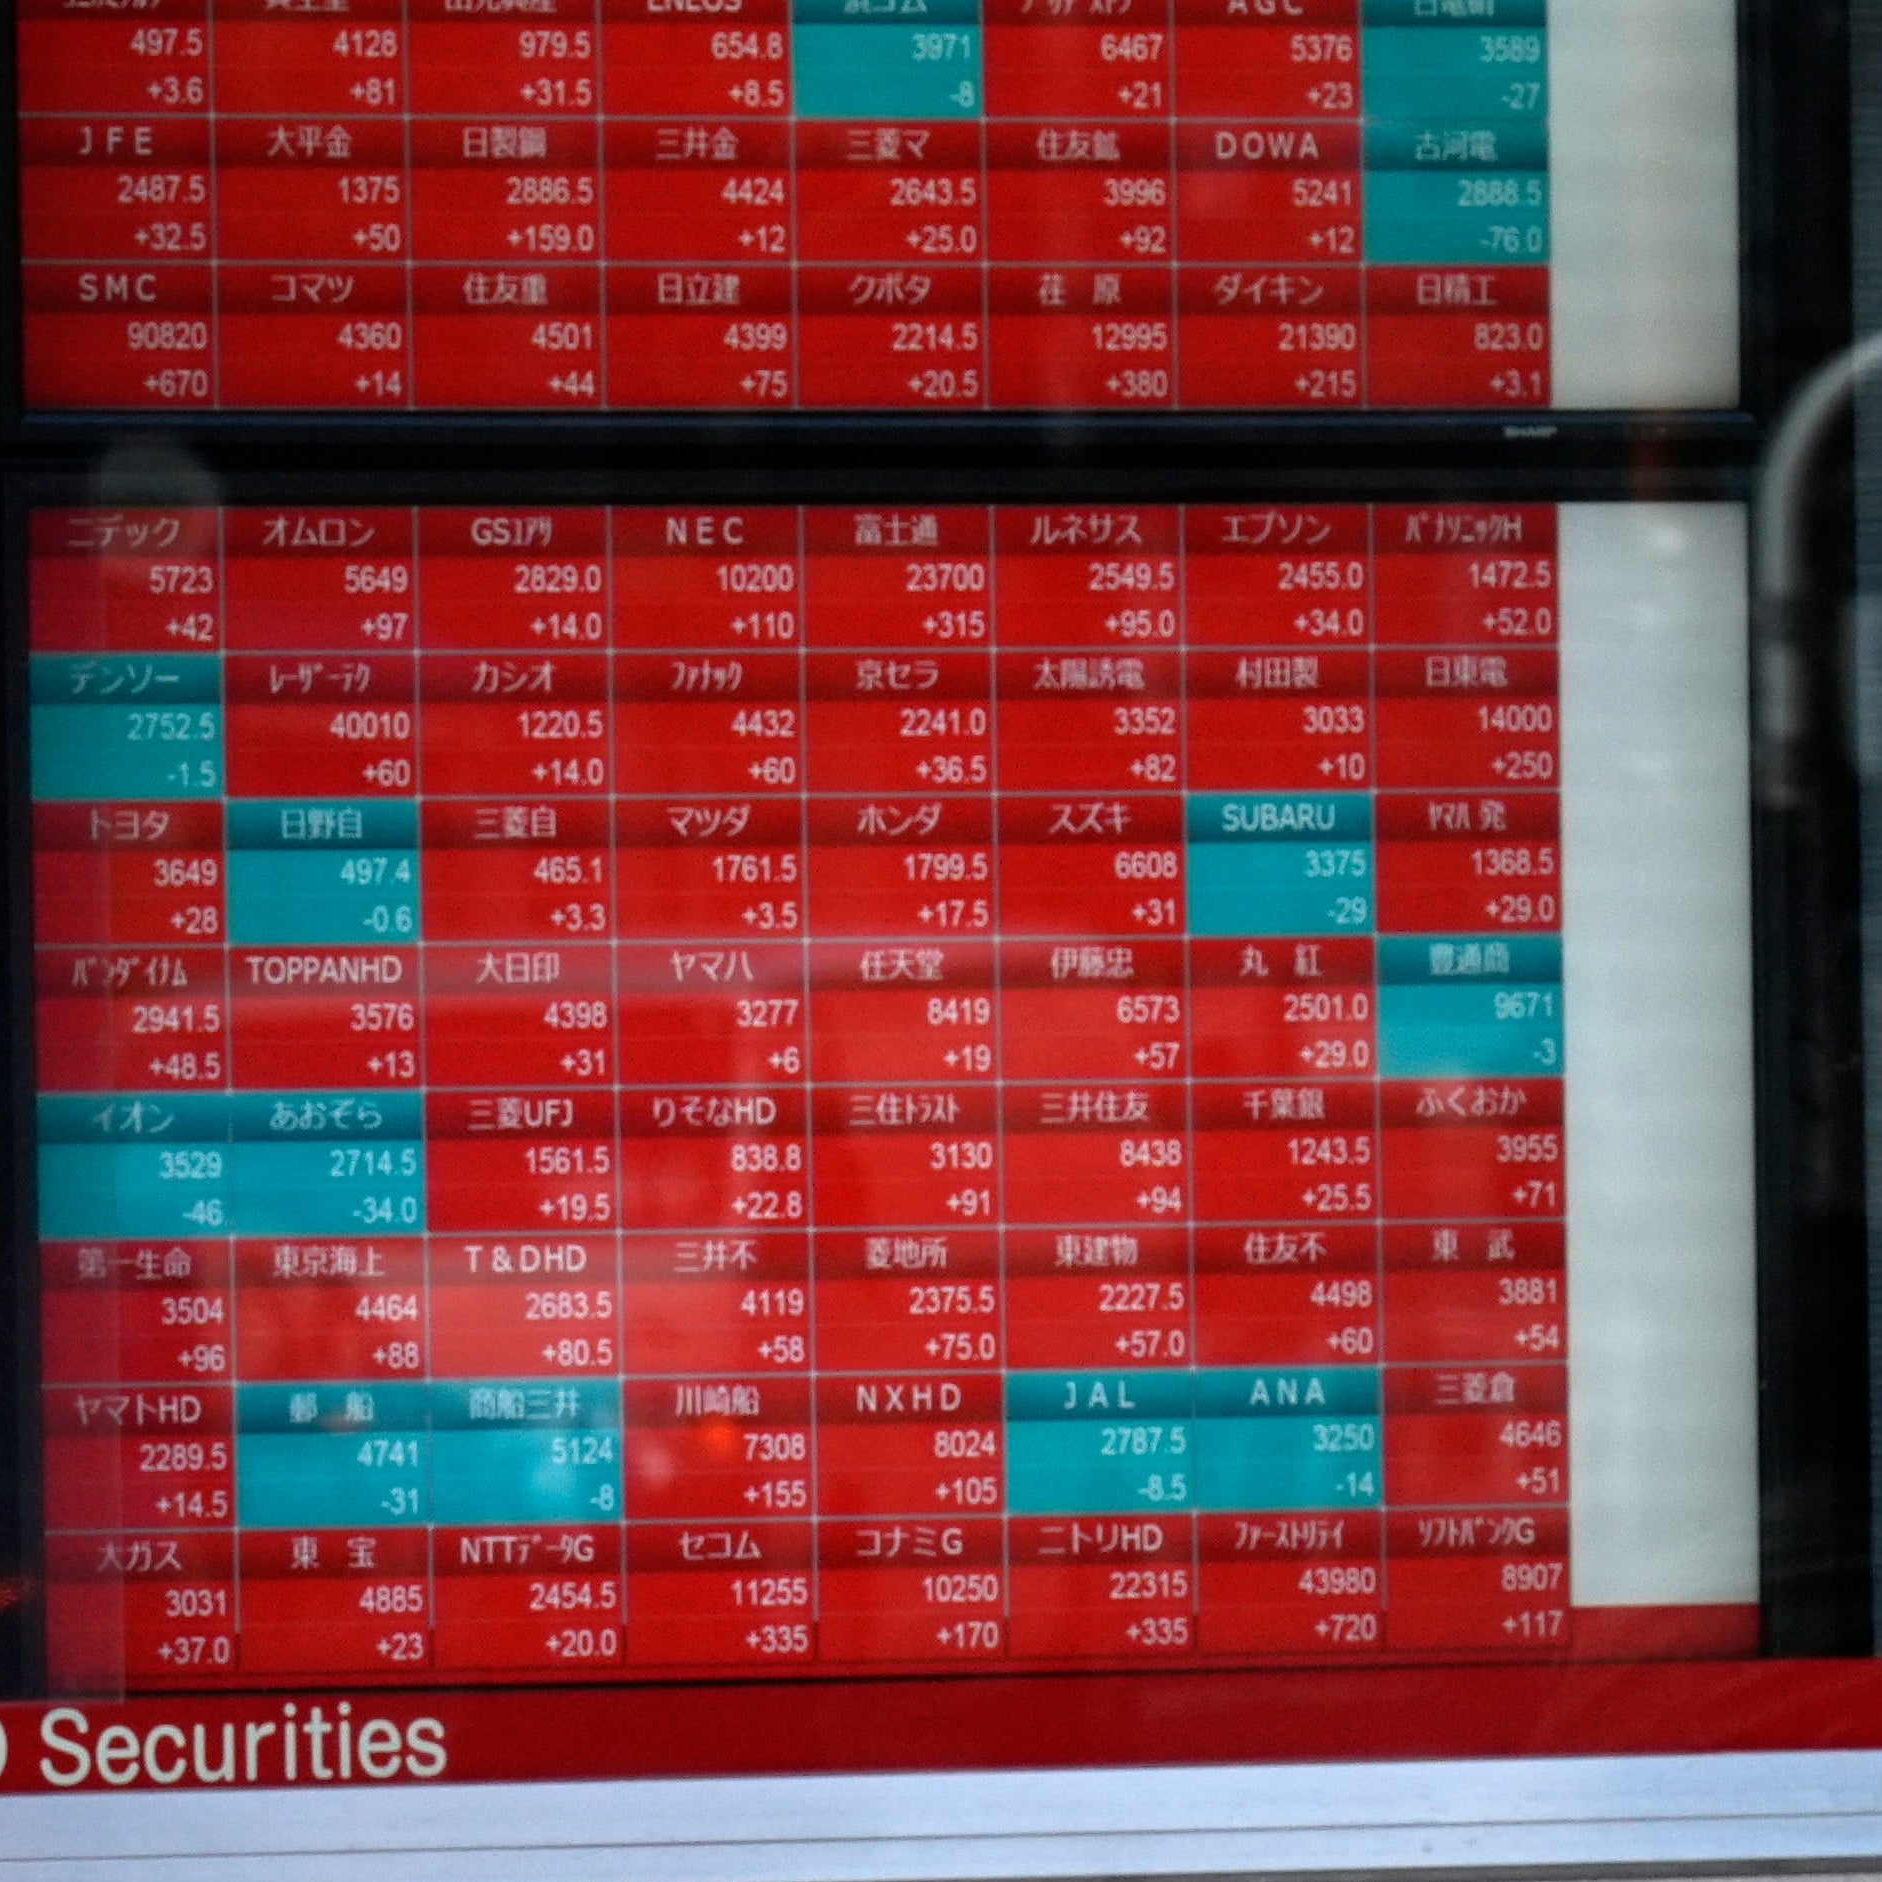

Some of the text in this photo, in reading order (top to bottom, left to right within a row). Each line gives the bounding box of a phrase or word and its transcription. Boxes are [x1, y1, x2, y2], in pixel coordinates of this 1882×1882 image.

[78, 125, 154, 156] JFE
[267, 124, 354, 159] 大平金
[1214, 130, 1320, 161] DOWA
[116, 173, 207, 204] 2487.5
[337, 174, 402, 205] 1375
[1291, 177, 1353, 207] 5241
[133, 221, 208, 252] +32.5
[351, 222, 403, 253] +50
[1307, 224, 1357, 255] +12
[77, 272, 158, 303] SMC
[272, 273, 356, 304] コマツ
[848, 271, 933, 305] クボタ
[1214, 272, 1324, 306] ダイキン
[126, 320, 209, 351] 90820
[335, 321, 404, 351] 4360
[890, 321, 980, 352] 2214.5
[1277, 321, 1359, 352] 21390
[142, 368, 210, 398] +670
[353, 369, 404, 397] +14
[906, 368, 980, 399] +20.5
[1293, 368, 1359, 399] +215
[264, 514, 376, 547] オムロン
[664, 515, 744, 546] NEC
[1029, 513, 1144, 545] ルネサス
[343, 564, 410, 594] 5649
[715, 562, 796, 593] 10200
[1087, 560, 1177, 592] 2549.5
[359, 611, 410, 642] +97
[729, 610, 796, 640] +110
[1103, 608, 1178, 639] +95.0
[471, 660, 556, 694] カシオ
[517, 709, 605, 740] 1220.5
[531, 756, 606, 787] +14.0
[667, 803, 752, 838] マツダ
[855, 802, 943, 836] ホンダ
[1222, 801, 1336, 833] SUBARU
[711, 853, 799, 883] 1761.5
[903, 851, 990, 881] 1799.5
[1304, 848, 1368, 878] 3375
[740, 900, 800, 931] +3.5
[916, 899, 991, 929] +17.5
[1327, 895, 1369, 925] -29
[248, 952, 403, 985] TOPPANHD
[858, 947, 945, 982] 任天堂
[349, 1001, 415, 1031] 3576
[925, 996, 993, 1027] 8419
[366, 1049, 417, 1079] +13
[942, 1043, 993, 1073] +19
[470, 1096, 575, 1130] 三菱UFJ
[524, 1145, 612, 1176] 1561.5
[538, 1190, 613, 1223] +19.5
[1242, 1231, 1327, 1265] 住友不
[1308, 1279, 1375, 1309] 4498
[1324, 1325, 1376, 1356] +60
[855, 1382, 963, 1413] NXHD
[1248, 1377, 1327, 1405] ANA
[932, 1428, 999, 1459] 8024
[1312, 1423, 1377, 1453] 3250
[933, 1475, 1000, 1506] +105
[1335, 1471, 1376, 1497] -14
[678, 1530, 763, 1561] セコム
[858, 1525, 965, 1558] コナミG
[1039, 1522, 1165, 1554] ニトリHD
[730, 1576, 810, 1607] 11255
[921, 1573, 1001, 1604] 10250
[1108, 1569, 1190, 1600] 22315
[744, 1623, 811, 1654] +335
[935, 1619, 1001, 1649] +170
[1124, 1616, 1190, 1646] +335
[39, 1701, 447, 1787] Securities
